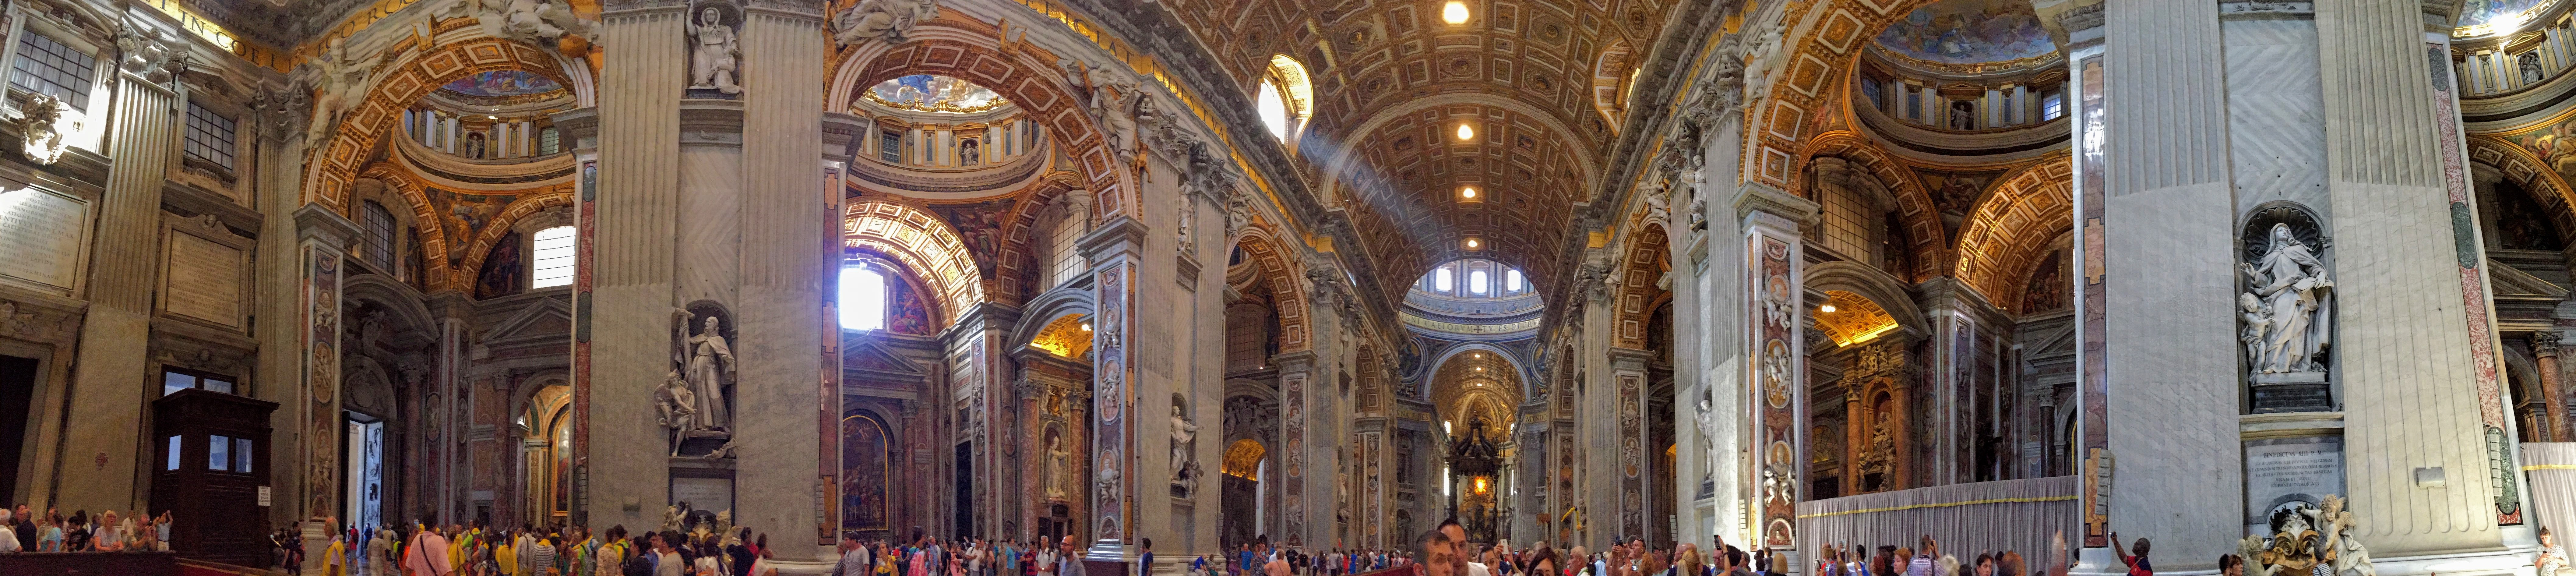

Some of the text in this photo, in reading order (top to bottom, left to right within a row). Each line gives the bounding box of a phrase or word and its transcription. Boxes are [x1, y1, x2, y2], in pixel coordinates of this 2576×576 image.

[182, 12, 206, 35] IN
[366, 0, 415, 27] RO
[1151, 60, 1195, 111] FIDES
[1201, 105, 1224, 141] TVA
[1425, 320, 1473, 332] CAELORVM
